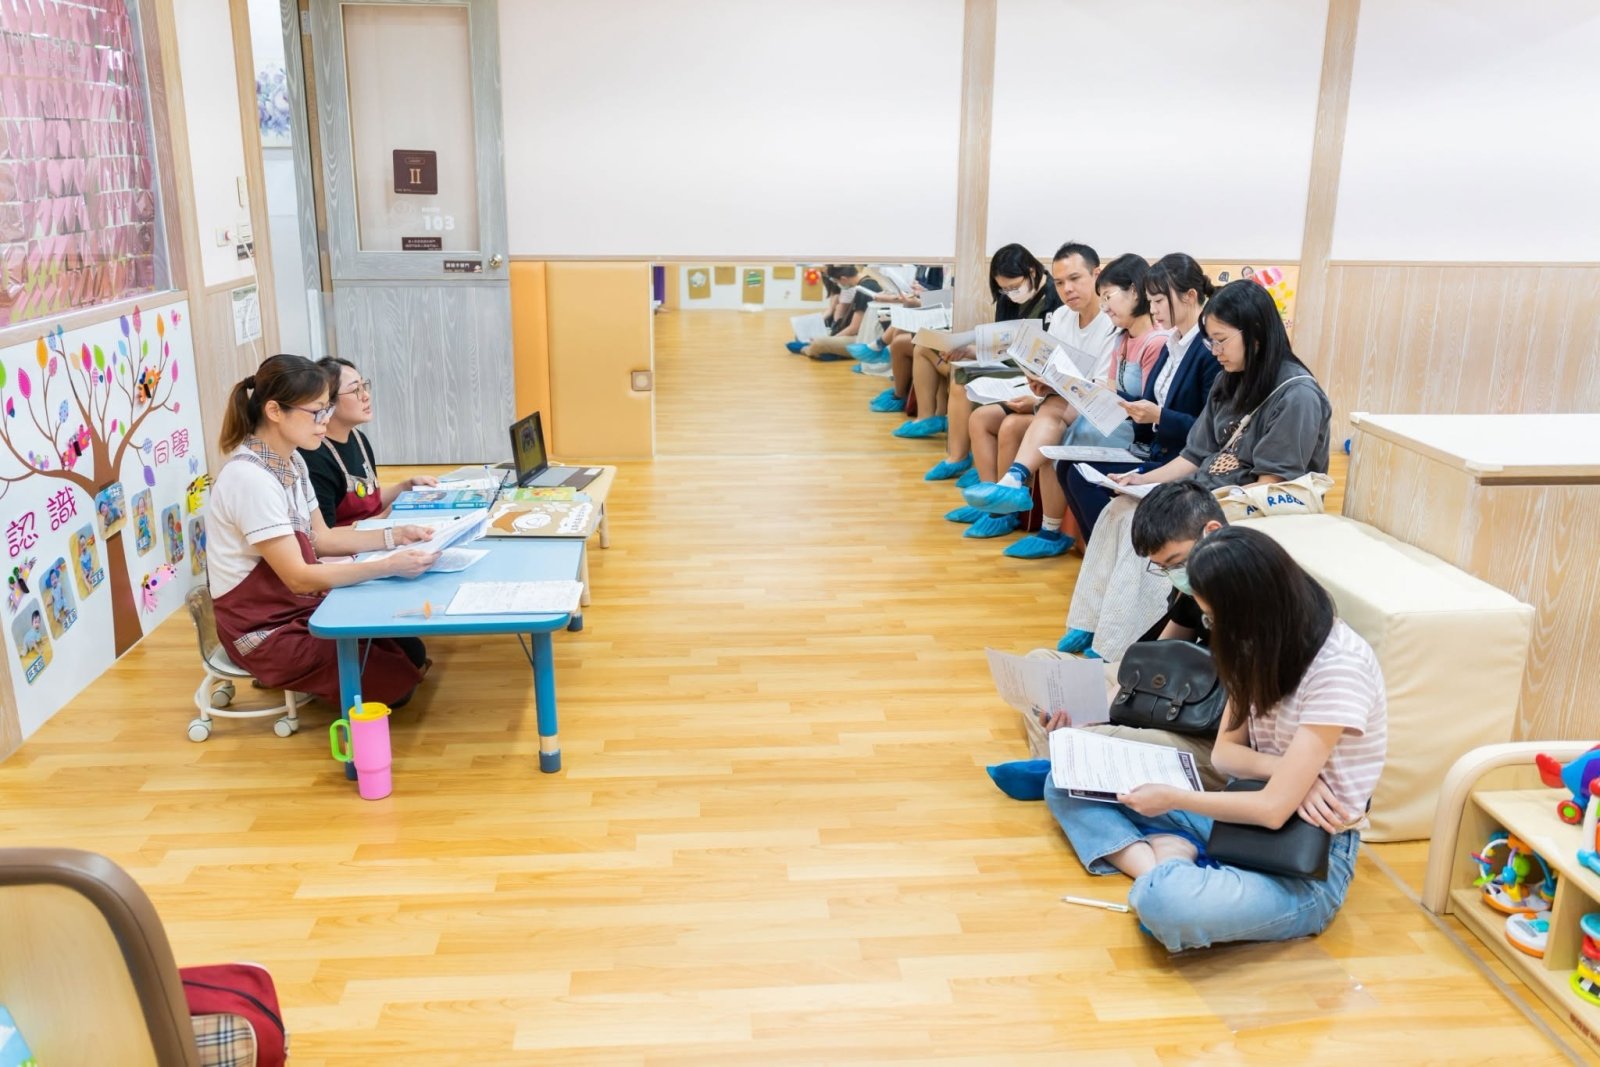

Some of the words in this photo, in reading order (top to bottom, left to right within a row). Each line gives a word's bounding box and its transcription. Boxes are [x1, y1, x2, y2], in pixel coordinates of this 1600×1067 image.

[409, 168, 422, 184] II
[423, 215, 455, 231] 103
[6, 486, 78, 558] 認識
[154, 428, 189, 468] 同學
